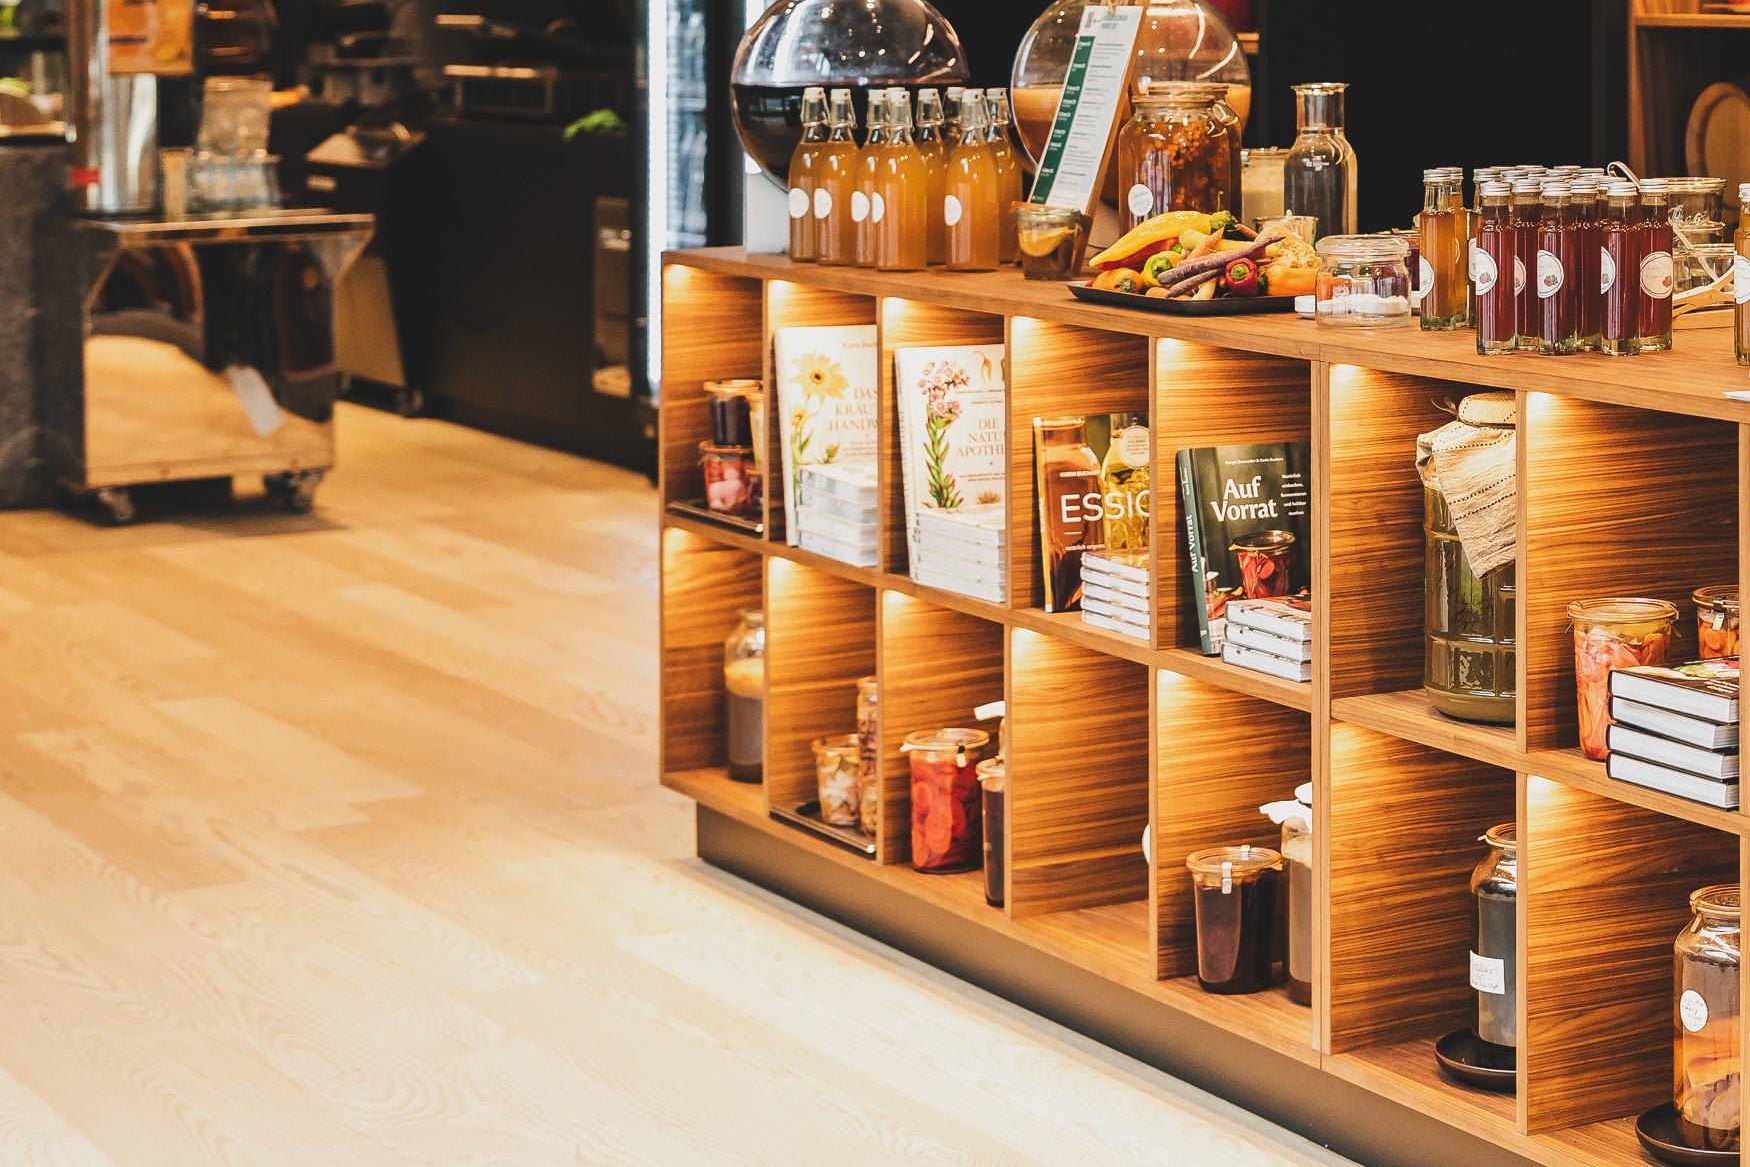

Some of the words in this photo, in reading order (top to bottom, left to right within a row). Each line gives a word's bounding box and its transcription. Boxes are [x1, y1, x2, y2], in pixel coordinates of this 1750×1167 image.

[976, 418, 1000, 430] DIE
[1223, 475, 1262, 501] Auf
[1210, 498, 1279, 523] Vorrat
[1185, 514, 1196, 551] Vorrat
